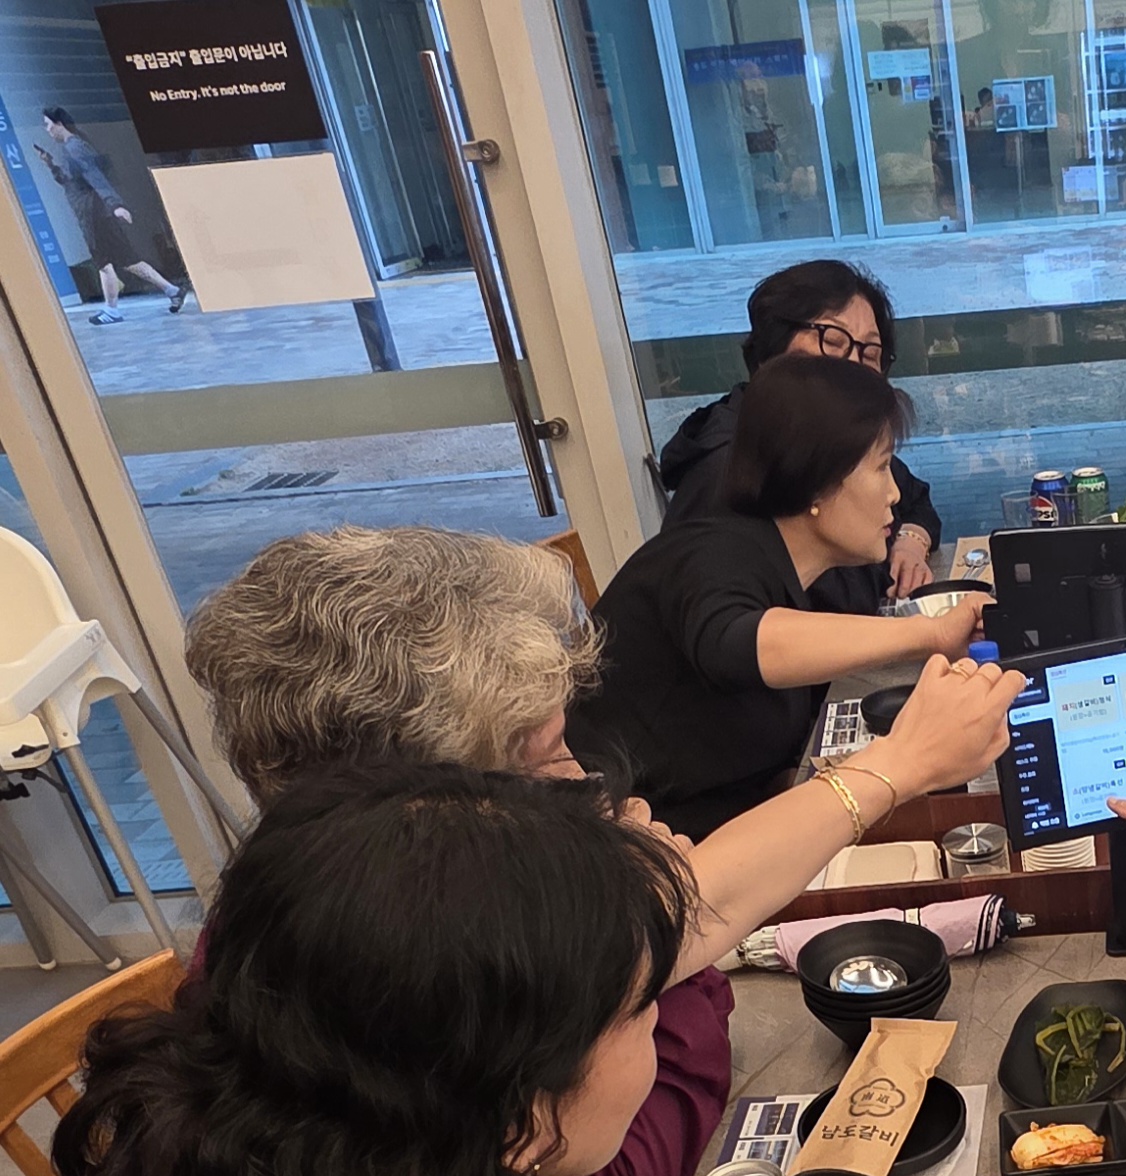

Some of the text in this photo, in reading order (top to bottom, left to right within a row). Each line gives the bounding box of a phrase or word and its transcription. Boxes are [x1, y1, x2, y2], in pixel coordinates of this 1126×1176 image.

[189, 46, 238, 65] 출입문이
[239, 41, 287, 61] 아닙니다
[150, 90, 167, 101] No
[201, 86, 219, 97] It's
[220, 84, 240, 96] not
[240, 82, 259, 94] the
[262, 81, 286, 91] door
[822, 1124, 900, 1147] 남도갈비
